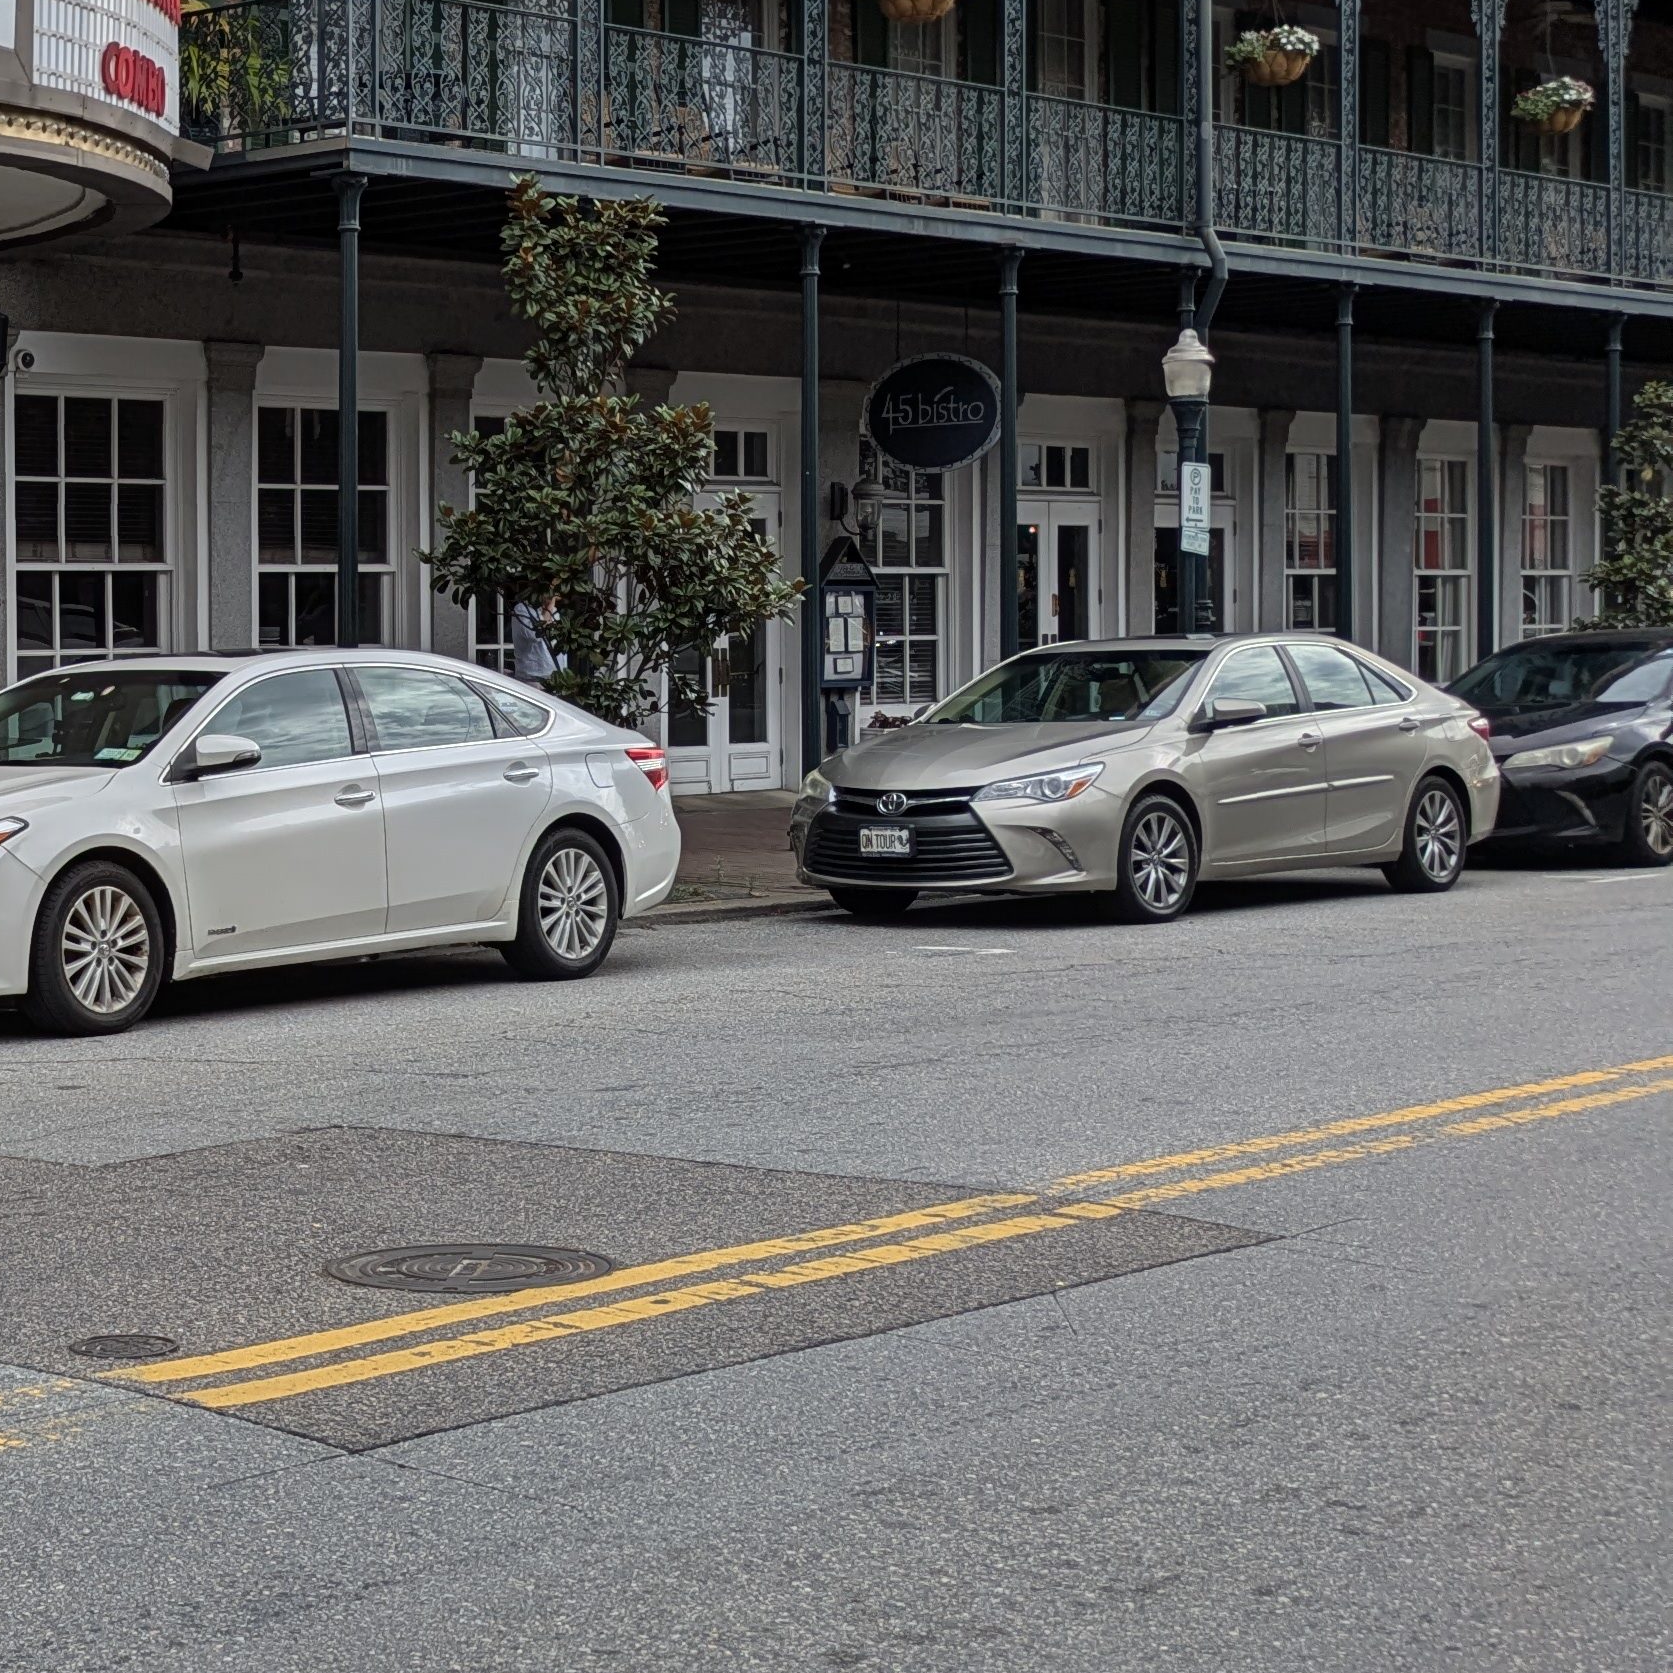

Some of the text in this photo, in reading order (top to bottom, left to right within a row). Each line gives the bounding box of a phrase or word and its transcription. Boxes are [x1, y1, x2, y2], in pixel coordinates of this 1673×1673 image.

[101, 41, 165, 118] COMBO
[882, 393, 912, 435] 45
[1190, 486, 1201, 496] PAY
[1192, 496, 1200, 506] TO
[1188, 506, 1203, 516] PARK
[874, 833, 897, 850] TOUR
